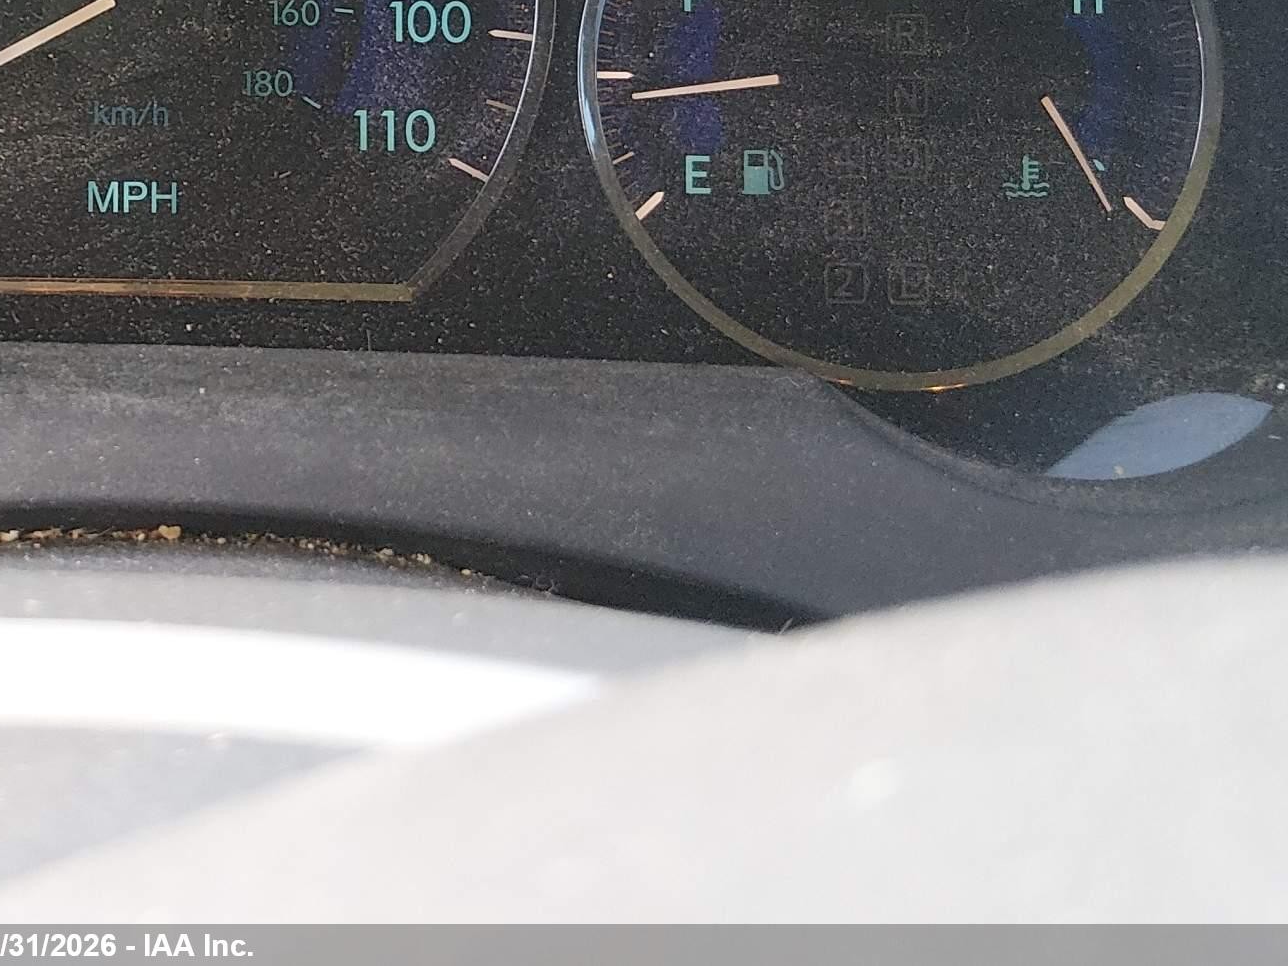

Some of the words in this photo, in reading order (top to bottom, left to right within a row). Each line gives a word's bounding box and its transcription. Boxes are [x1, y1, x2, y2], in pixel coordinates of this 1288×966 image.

[270, 0, 319, 26] 160
[391, 0, 471, 44] 100
[244, 71, 293, 97] 180
[93, 102, 168, 127] km/h
[354, 110, 435, 152] 110
[686, 155, 711, 194] E
[87, 182, 178, 214] MPH
